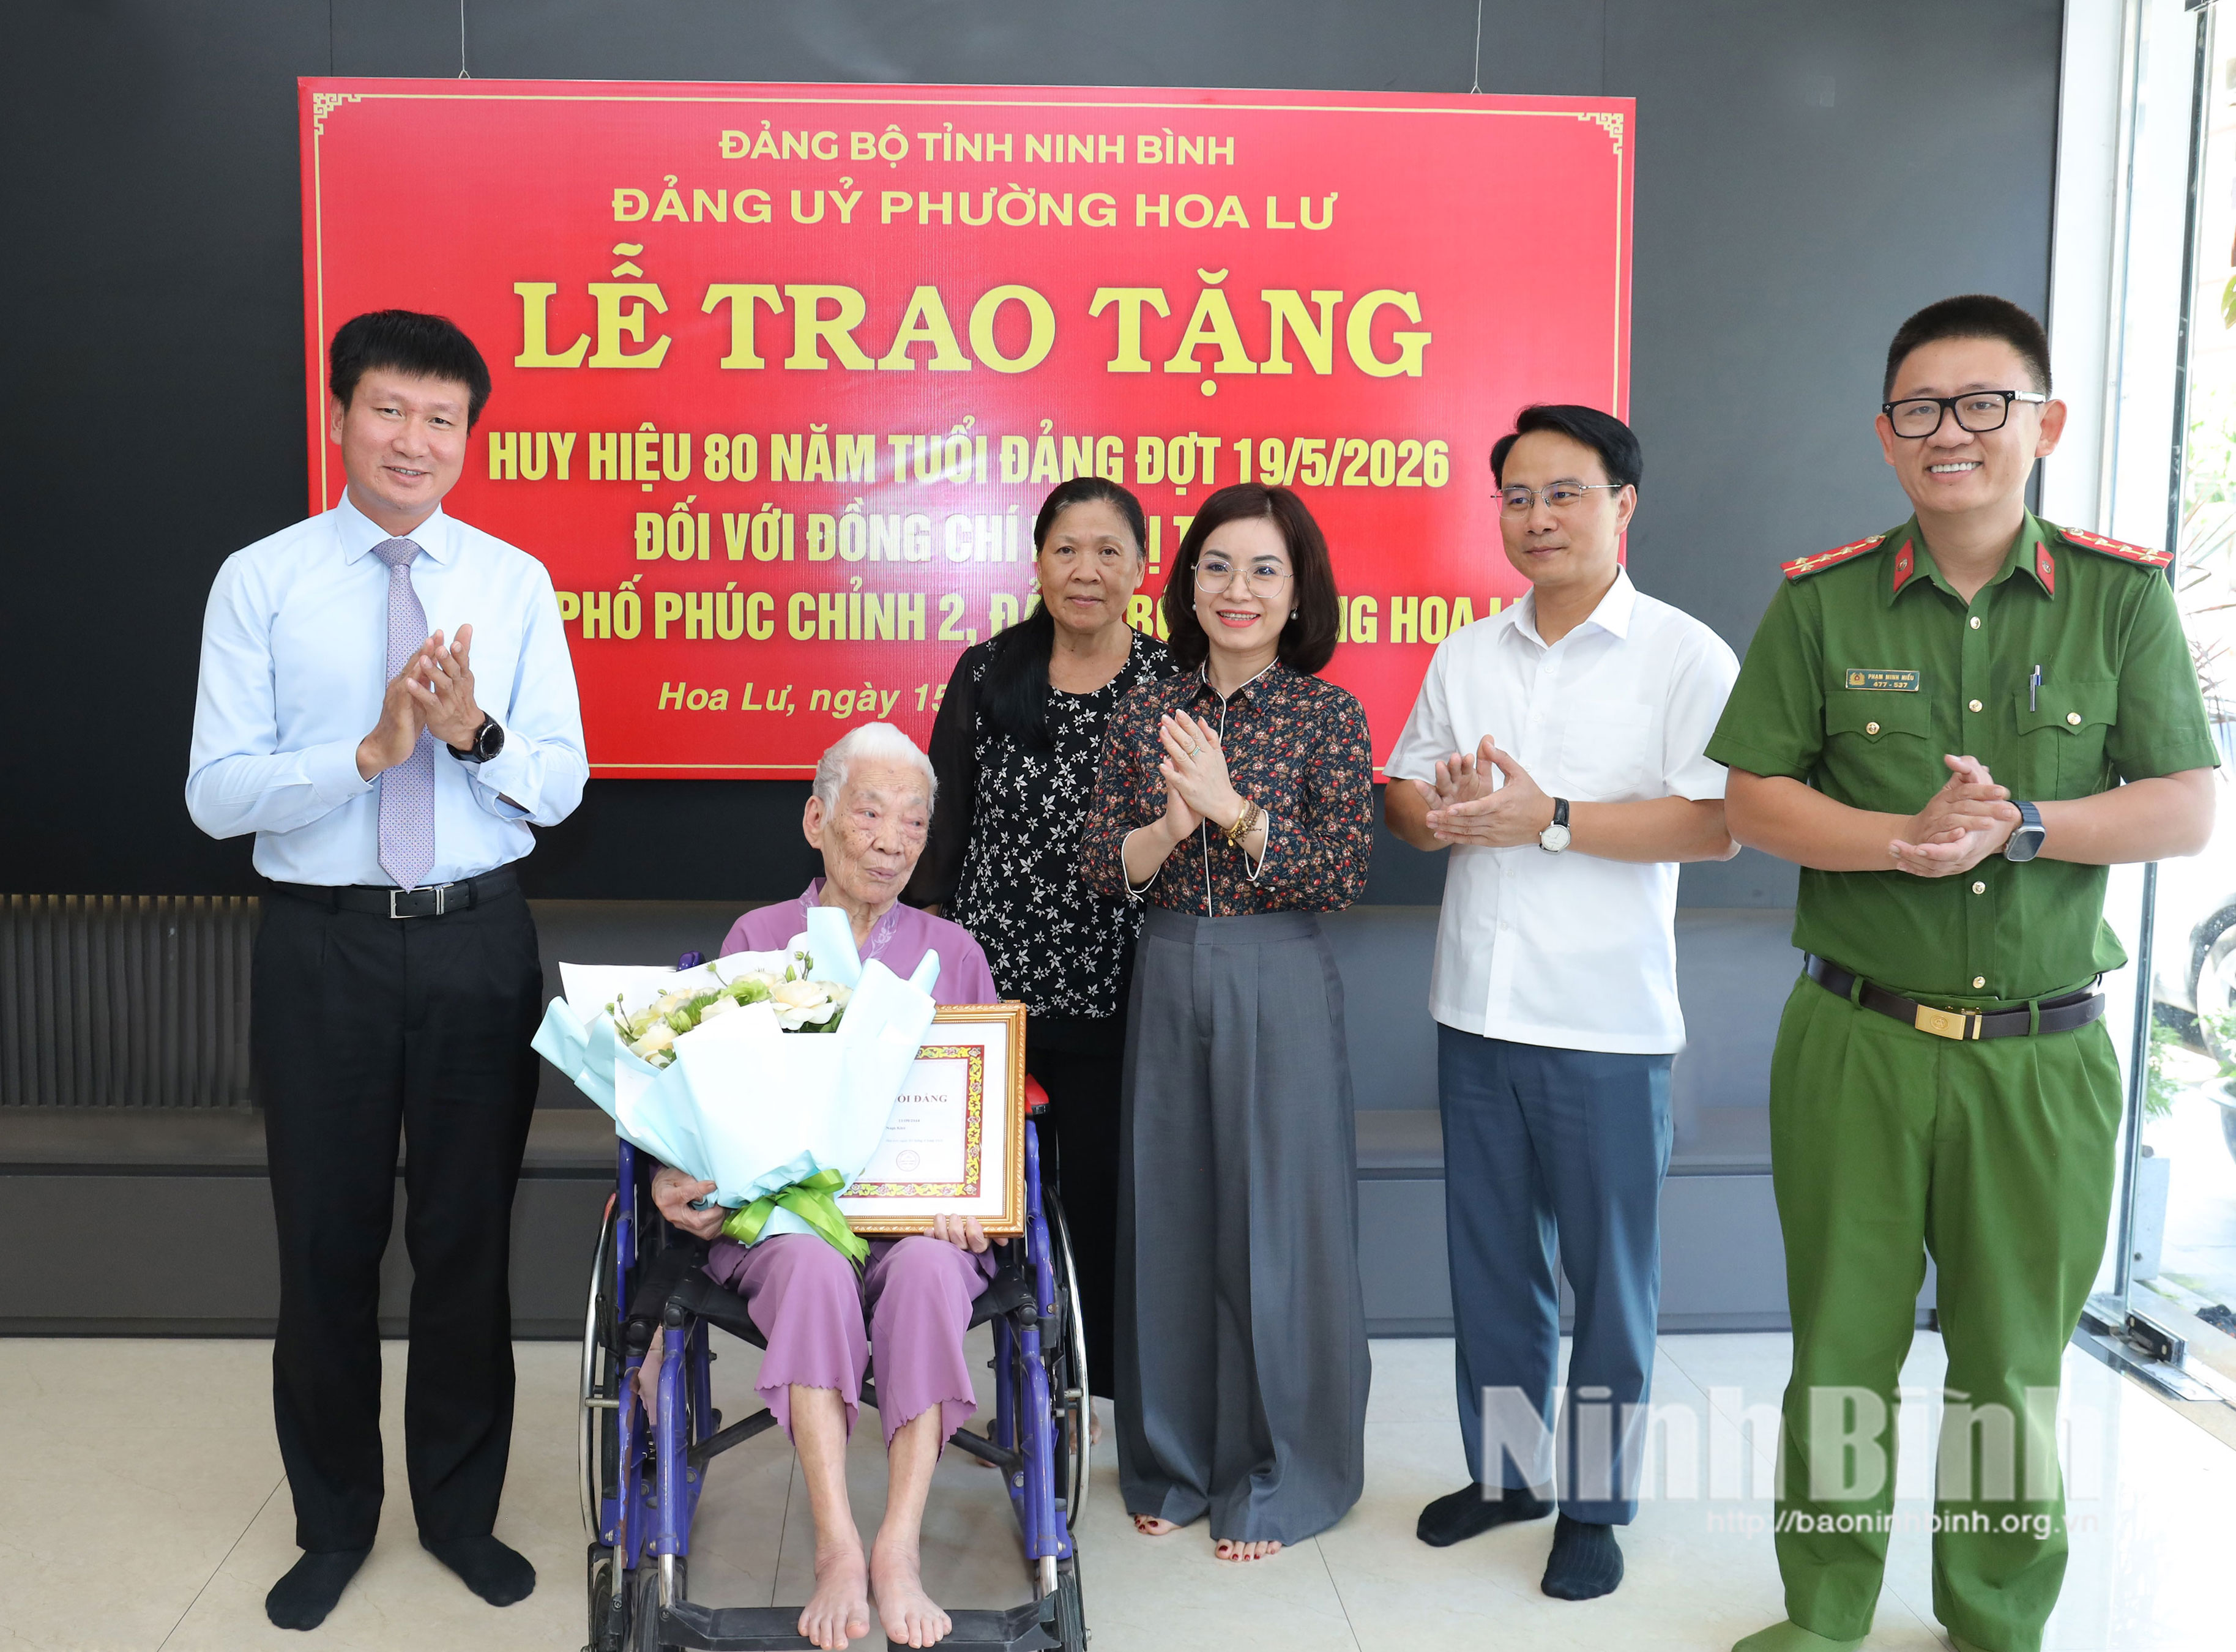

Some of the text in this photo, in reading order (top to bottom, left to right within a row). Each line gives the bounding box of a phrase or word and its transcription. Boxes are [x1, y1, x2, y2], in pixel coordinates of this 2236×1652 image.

[718, 120, 1234, 168] ĐẢNG BỘ TỈNH NINH BÌNH
[612, 175, 1338, 230] ĐẢNG UỶ PHƯỜNG HOA LƯ
[514, 243, 1432, 396] LỄ TRAO TẶNG
[489, 415, 1450, 496] HUY HIỆU 80 NĂM TUỔI ĐẢNG ĐỢT 19/5/2026
[634, 495, 710, 561] ĐỐI
[722, 502, 794, 561] VỚI
[806, 497, 931, 562] ĐỒNG
[945, 504, 1017, 563] CHÍ
[554, 574, 643, 639] PHỐ
[655, 581, 775, 640] PHÚC
[788, 576, 925, 641] CHỈNH
[937, 593, 977, 647] 2,
[658, 682, 948, 719] Hoa Lư, ngày 15
